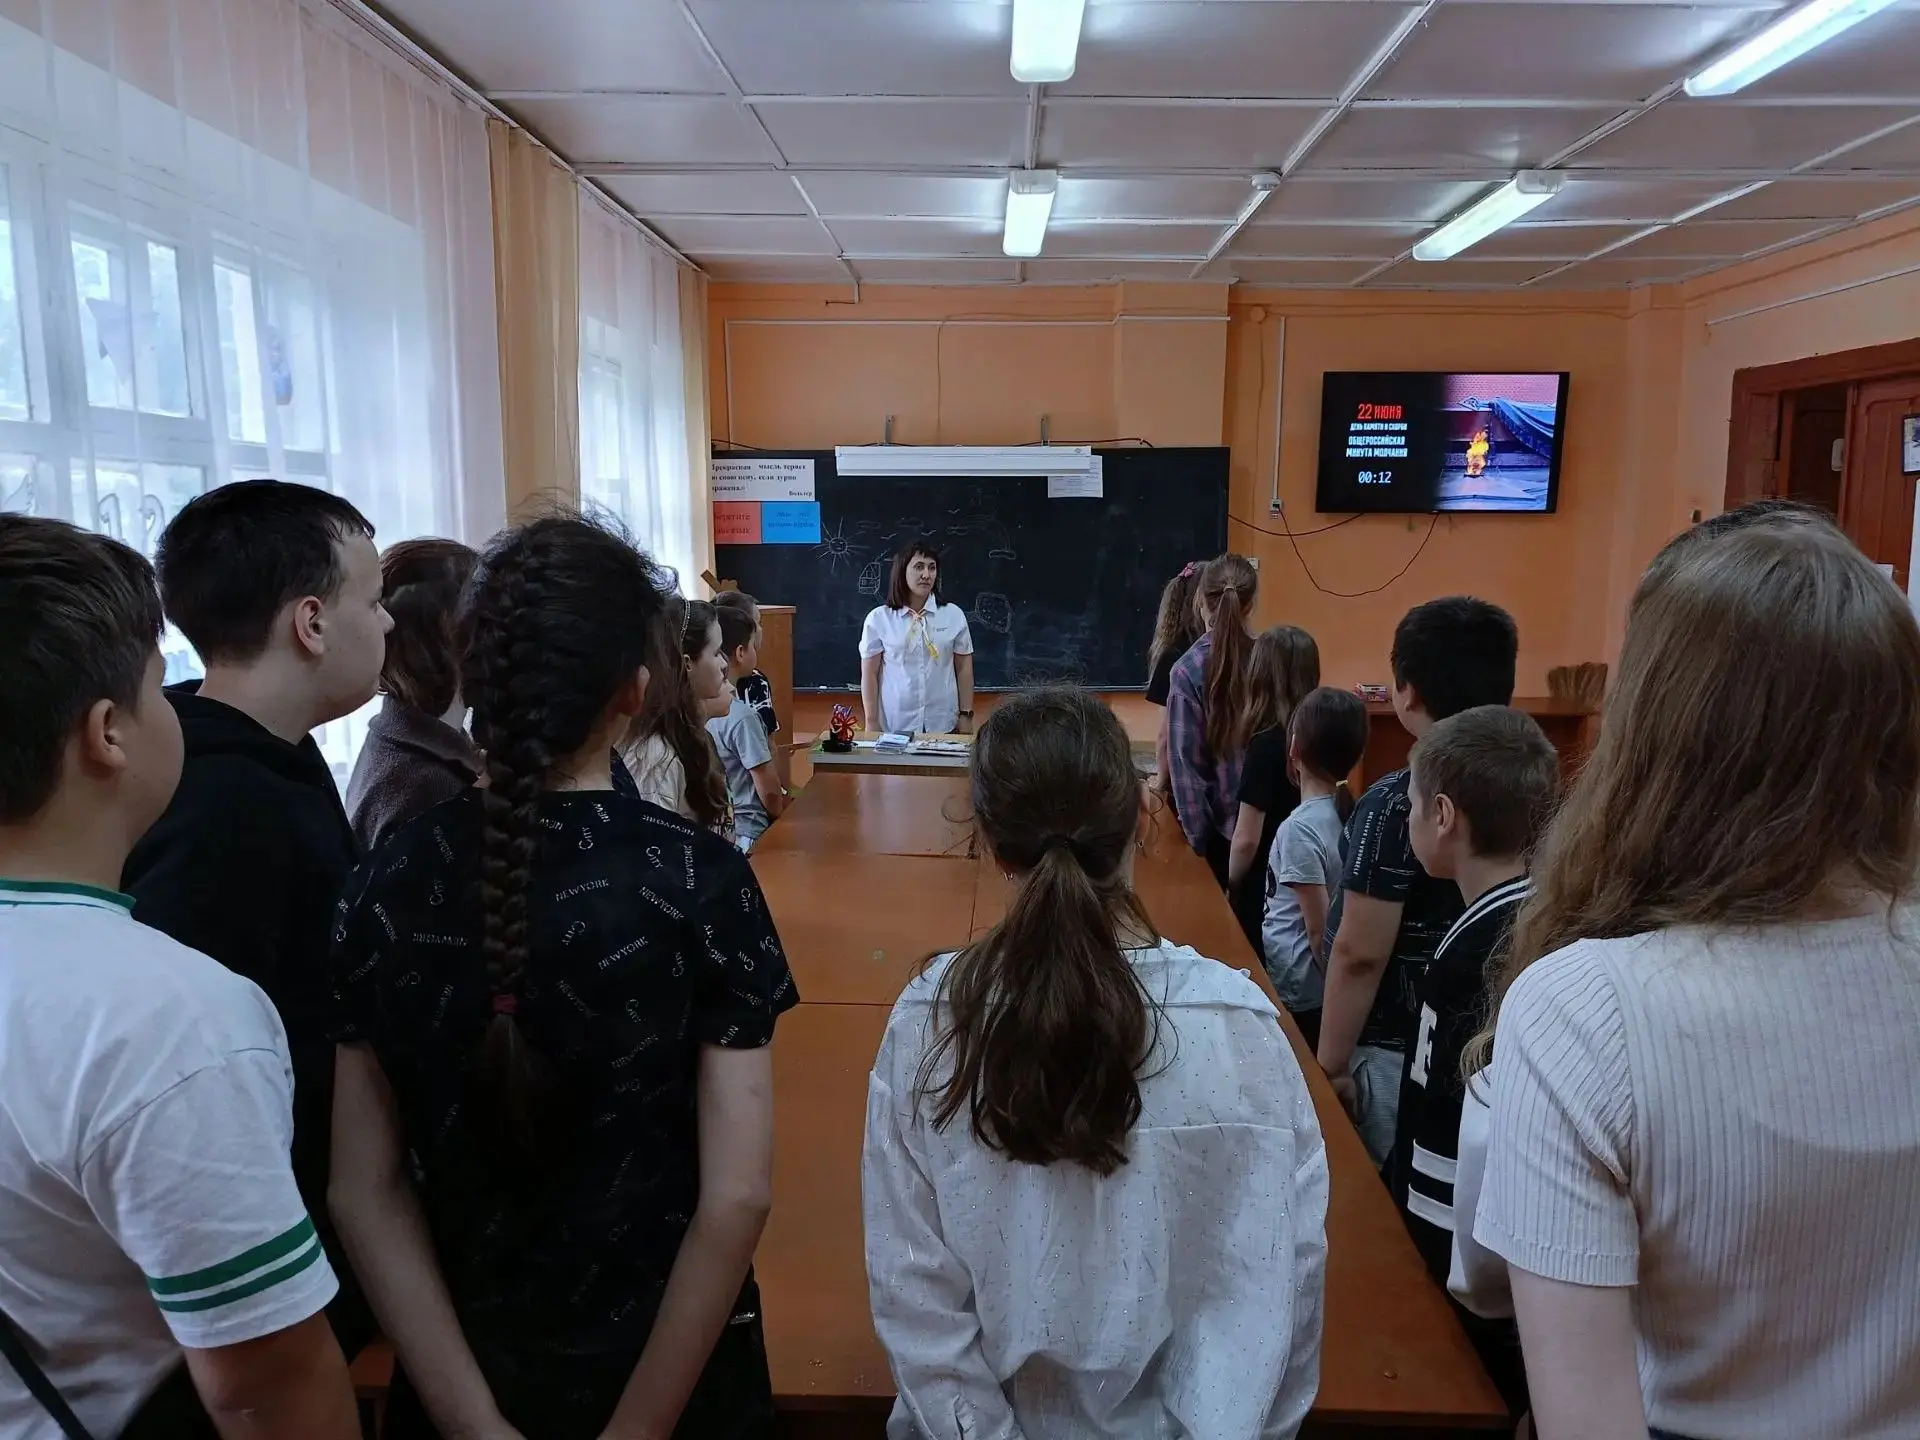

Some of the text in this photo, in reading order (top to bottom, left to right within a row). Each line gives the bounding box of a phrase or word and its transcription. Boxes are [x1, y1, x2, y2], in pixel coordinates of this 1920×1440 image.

[1357, 404, 1372, 419] 22
[1348, 434, 1406, 446] ОБЩЕРОССИЙСКАЯ
[1346, 448, 1408, 457] МИНУТА МОЛЧАНИЯ
[1358, 471, 1392, 484] 00:12
[1363, 811, 1374, 837] BELIEVE
